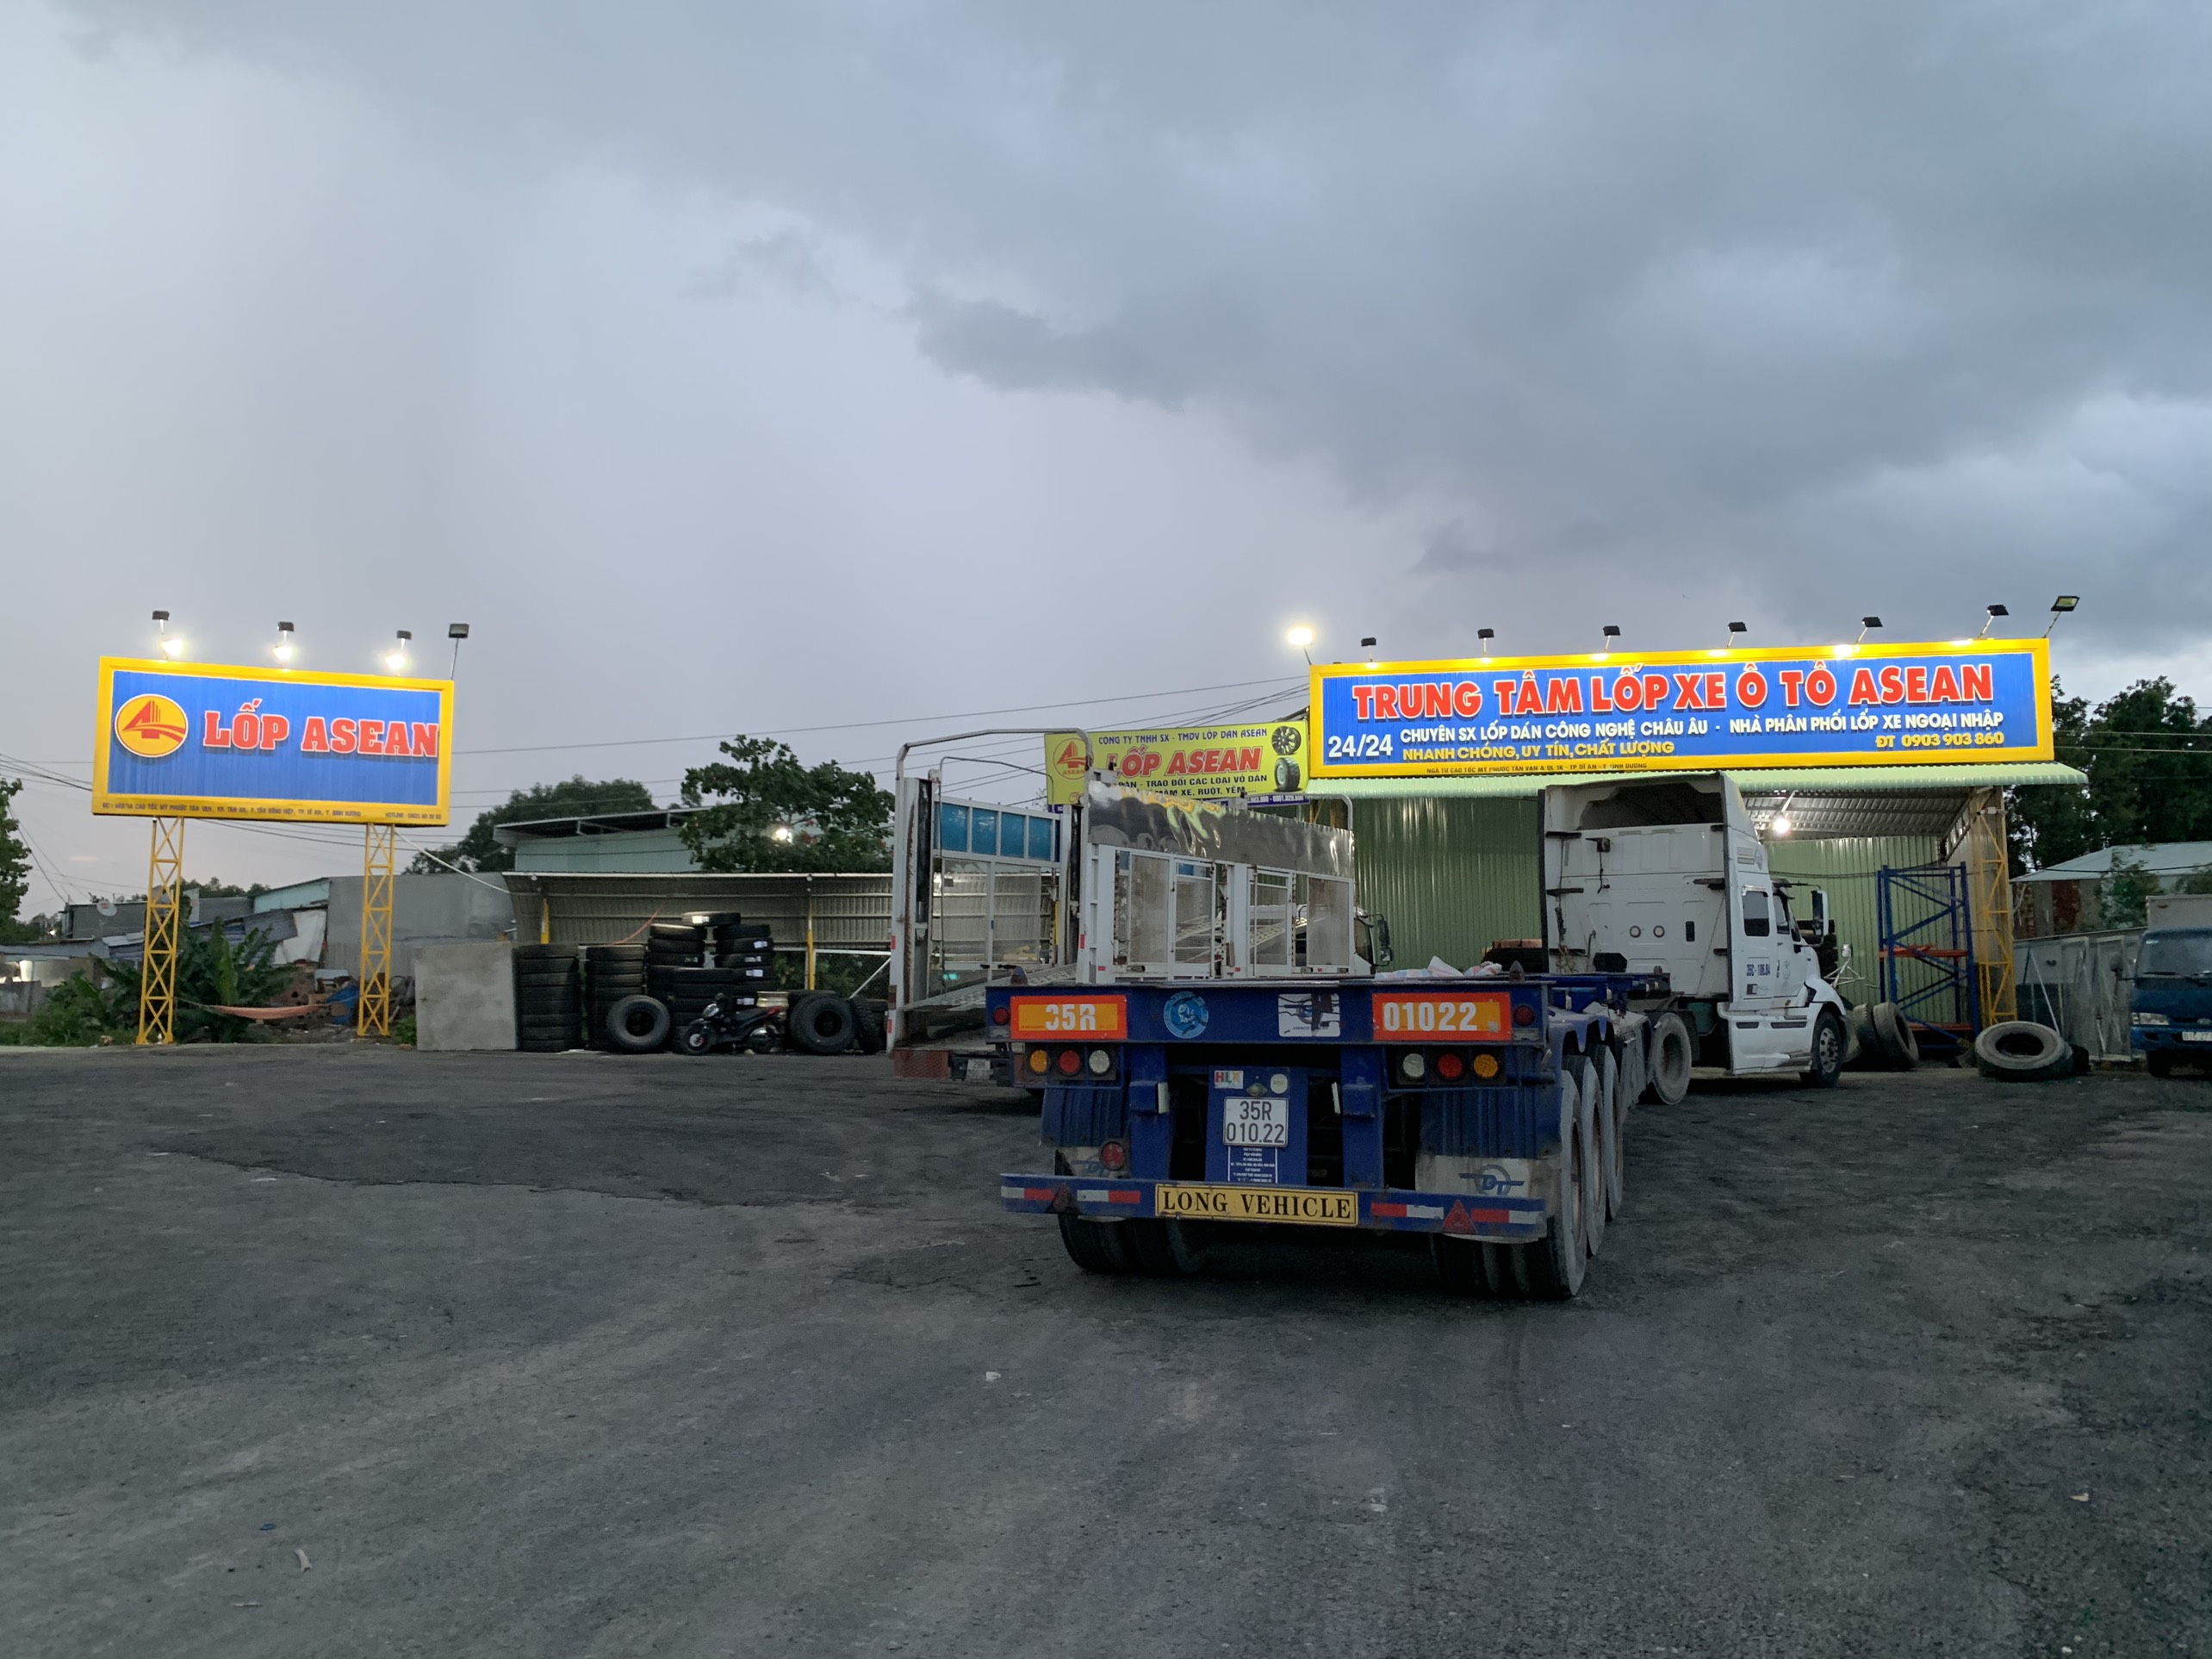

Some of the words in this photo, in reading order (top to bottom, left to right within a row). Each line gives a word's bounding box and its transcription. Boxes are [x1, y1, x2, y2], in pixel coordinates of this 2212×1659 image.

[1352, 680, 1483, 720] TRUNG
[1494, 669, 1584, 716] TÂM
[1591, 663, 1670, 714] LỐP
[1674, 671, 1727, 710] XE
[1736, 662, 1768, 709] Ô
[1780, 660, 1837, 707] TÔ
[1849, 663, 1994, 706] ASEAN
[202, 698, 291, 750] LỐP
[301, 716, 440, 758] ASEAN
[1123, 736, 1133, 744] TY
[1135, 735, 1158, 743] TNHH
[1159, 733, 1170, 743] SX
[1177, 732, 1200, 741] TMDV
[1240, 729, 1267, 738] ASEAN
[1400, 724, 1456, 743] CHUYÊN
[1458, 726, 1476, 742] SX
[1480, 718, 1507, 741] LỐP
[1510, 721, 1542, 739] DÁN
[1545, 720, 1591, 738] CÔNG
[1595, 718, 1636, 740] NGHỆ
[1640, 717, 1684, 736] CHÂU
[1687, 717, 1708, 735] ÂU
[1730, 714, 1763, 734] NHÀ
[1766, 713, 1807, 732] PHÂN
[1811, 708, 1847, 731] PHỐI
[1851, 708, 1879, 730] LỐP
[1882, 714, 1902, 730] XE
[1905, 712, 1957, 731] NGOẠI
[1961, 708, 2004, 731] NHẬP
[1327, 733, 1394, 758] 24/24
[1402, 747, 1455, 761] NHANH
[1521, 746, 1542, 758] UY
[1575, 738, 1617, 756] CHẤT
[1619, 739, 1675, 759] LƯỢNG
[1875, 735, 1895, 748] ĐT
[1901, 734, 1941, 747] 0903
[1942, 733, 1973, 746] 903
[1974, 731, 2004, 745] 860
[1165, 746, 1264, 777] ASEAN
[1146, 779, 1169, 787] TRAO
[1045, 1003, 1097, 1031] 35R
[1383, 1002, 1478, 1032] 01022
[1240, 1101, 1272, 1121] 35R
[1226, 1122, 1285, 1144] 010.22
[1163, 1190, 1228, 1213] LONG
[1240, 1193, 1351, 1219] VEHICLE
